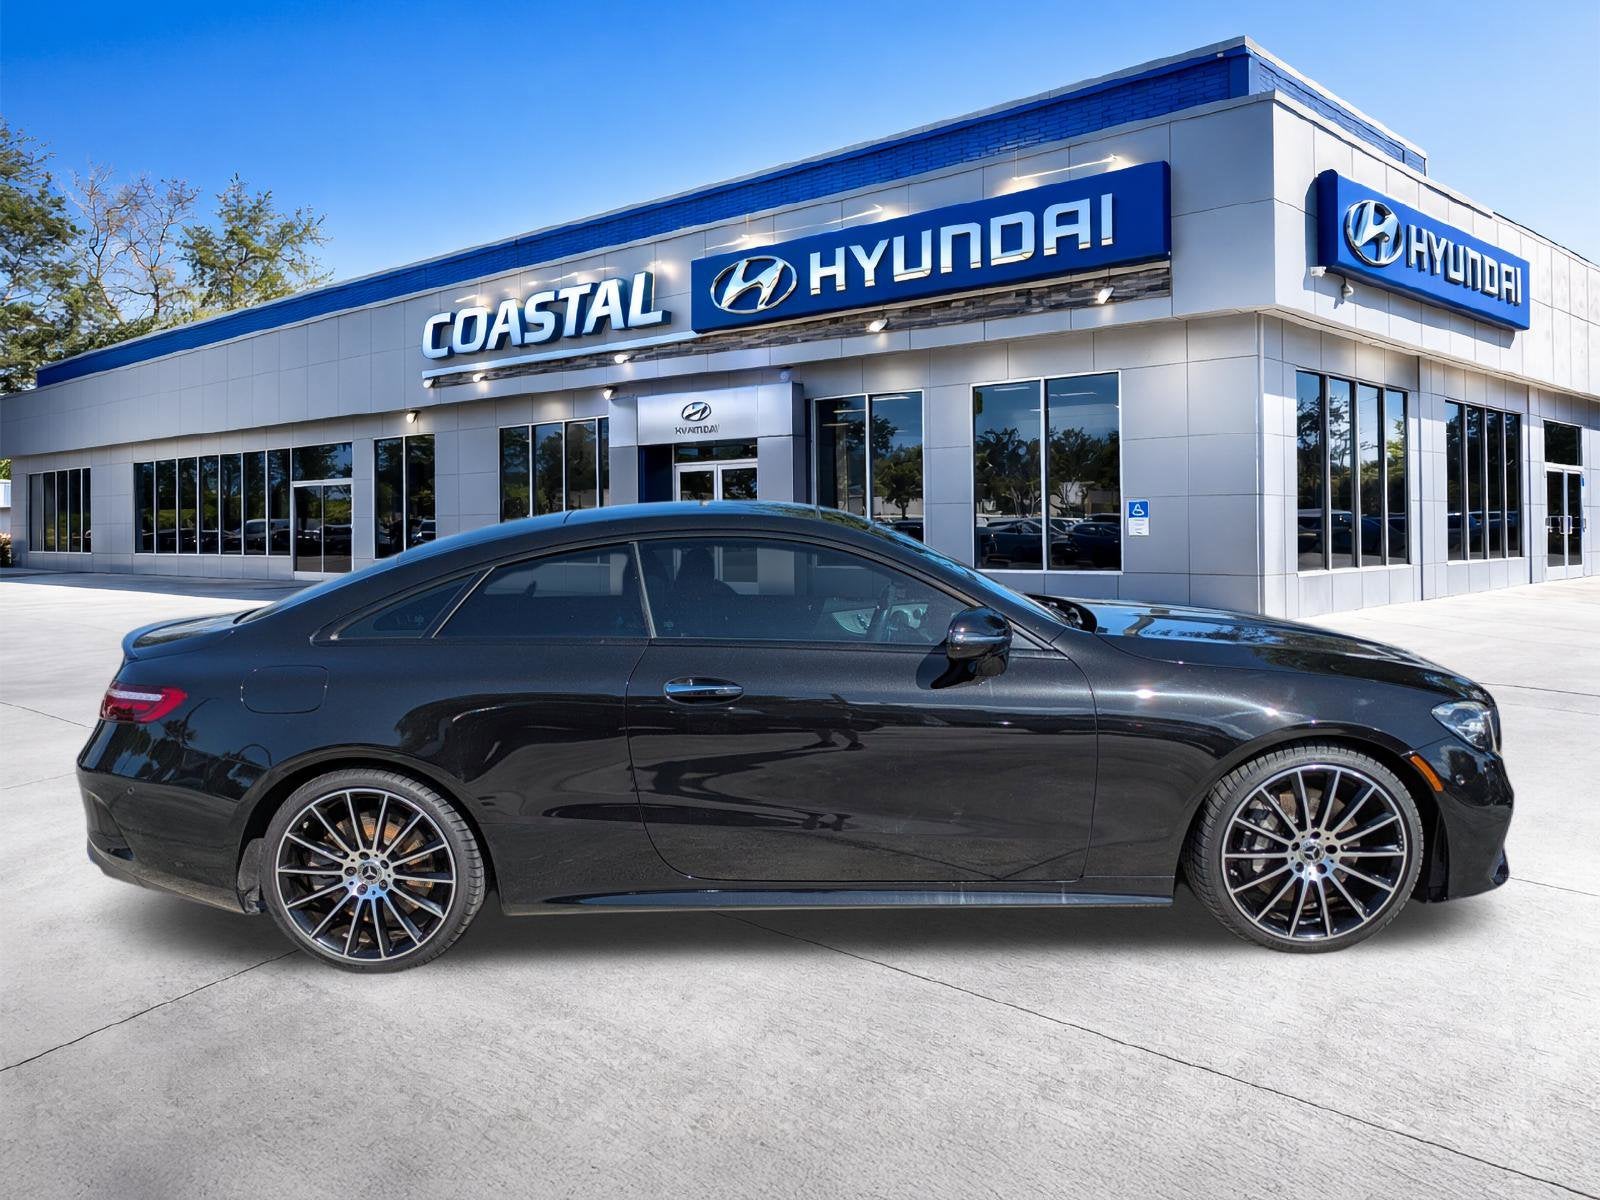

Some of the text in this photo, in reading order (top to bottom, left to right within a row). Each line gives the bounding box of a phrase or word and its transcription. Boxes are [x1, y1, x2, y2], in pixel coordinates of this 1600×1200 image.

[809, 193, 1114, 296] HYUNDAI
[1406, 224, 1522, 306] HYUNDAI
[422, 271, 670, 360] COASTAL
